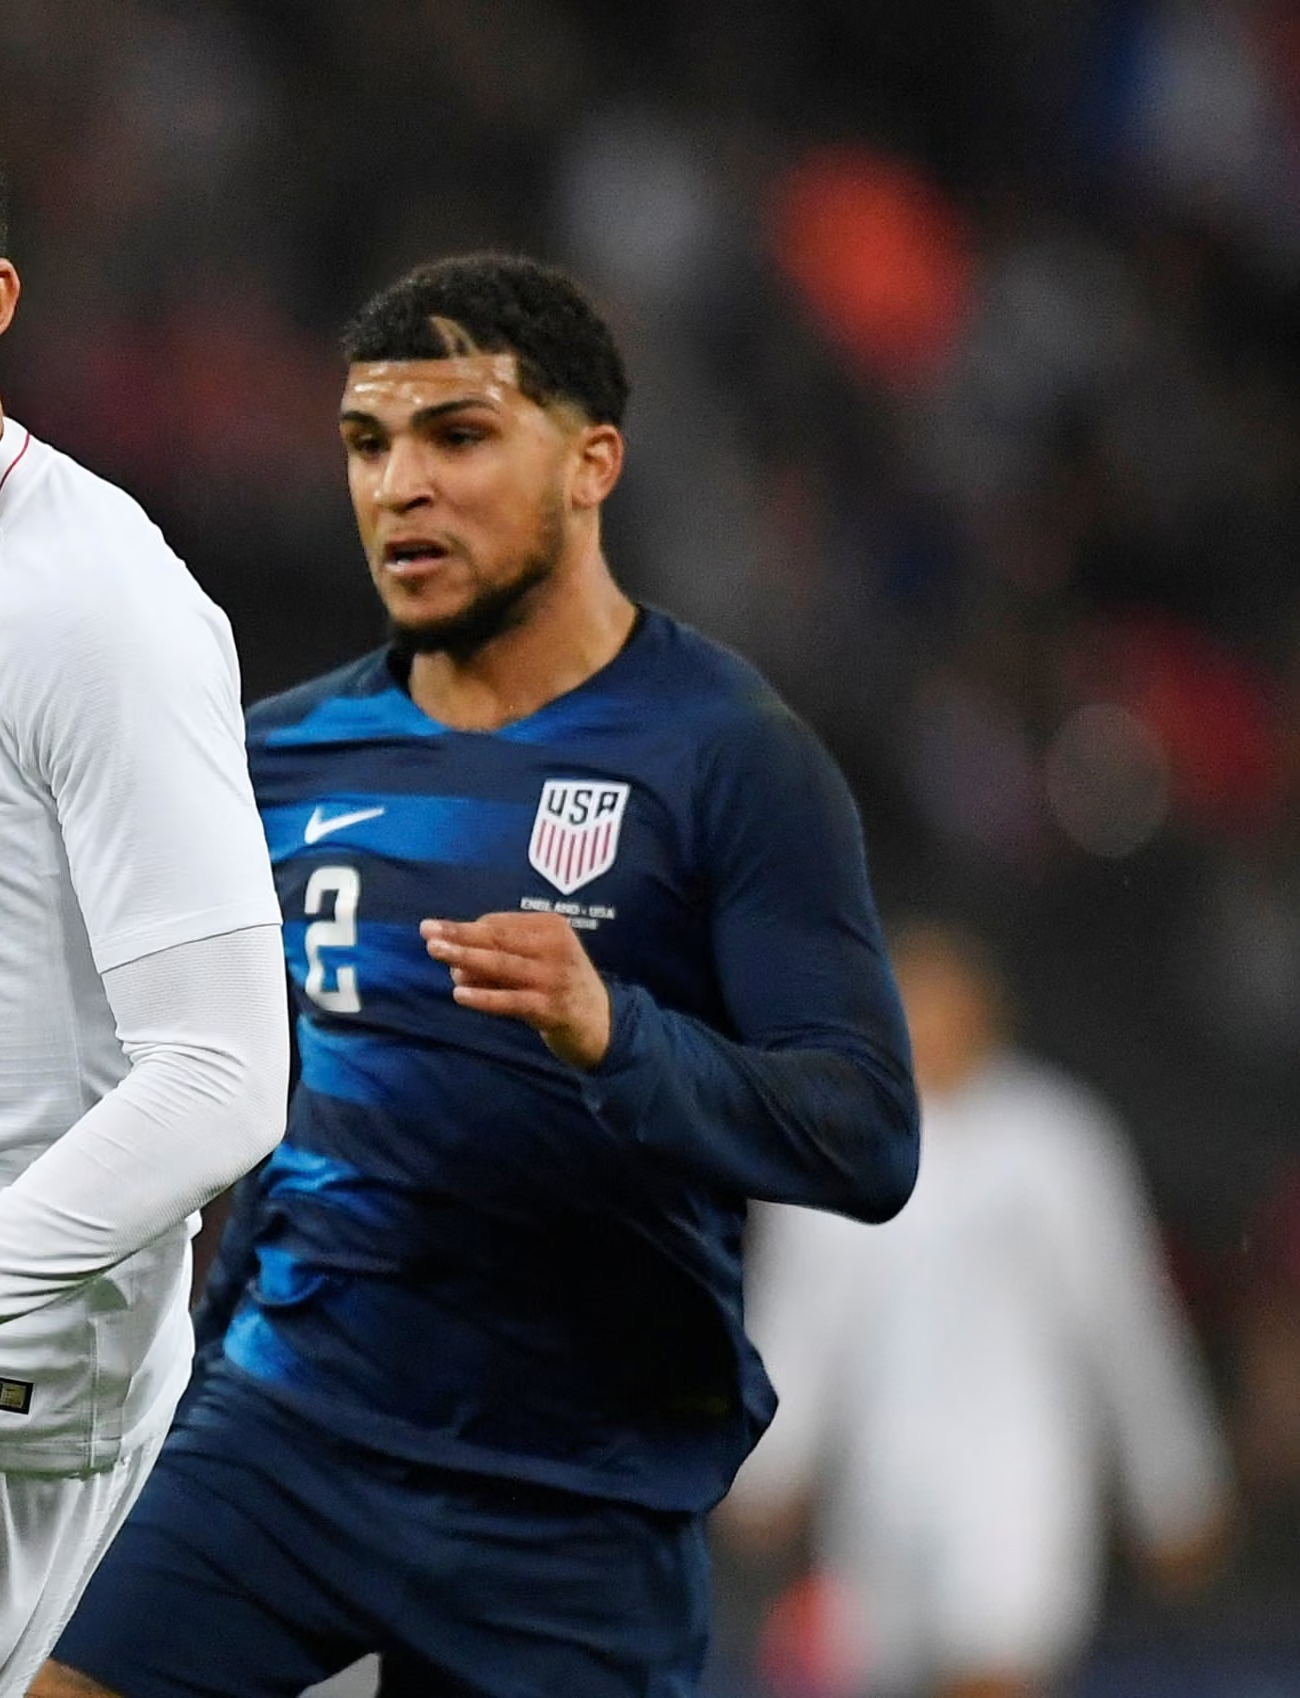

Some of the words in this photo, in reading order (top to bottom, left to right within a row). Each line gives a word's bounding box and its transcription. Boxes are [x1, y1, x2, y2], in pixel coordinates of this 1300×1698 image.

[547, 788, 620, 826] USA
[589, 905, 615, 920] USA
[304, 865, 362, 1014] 2
